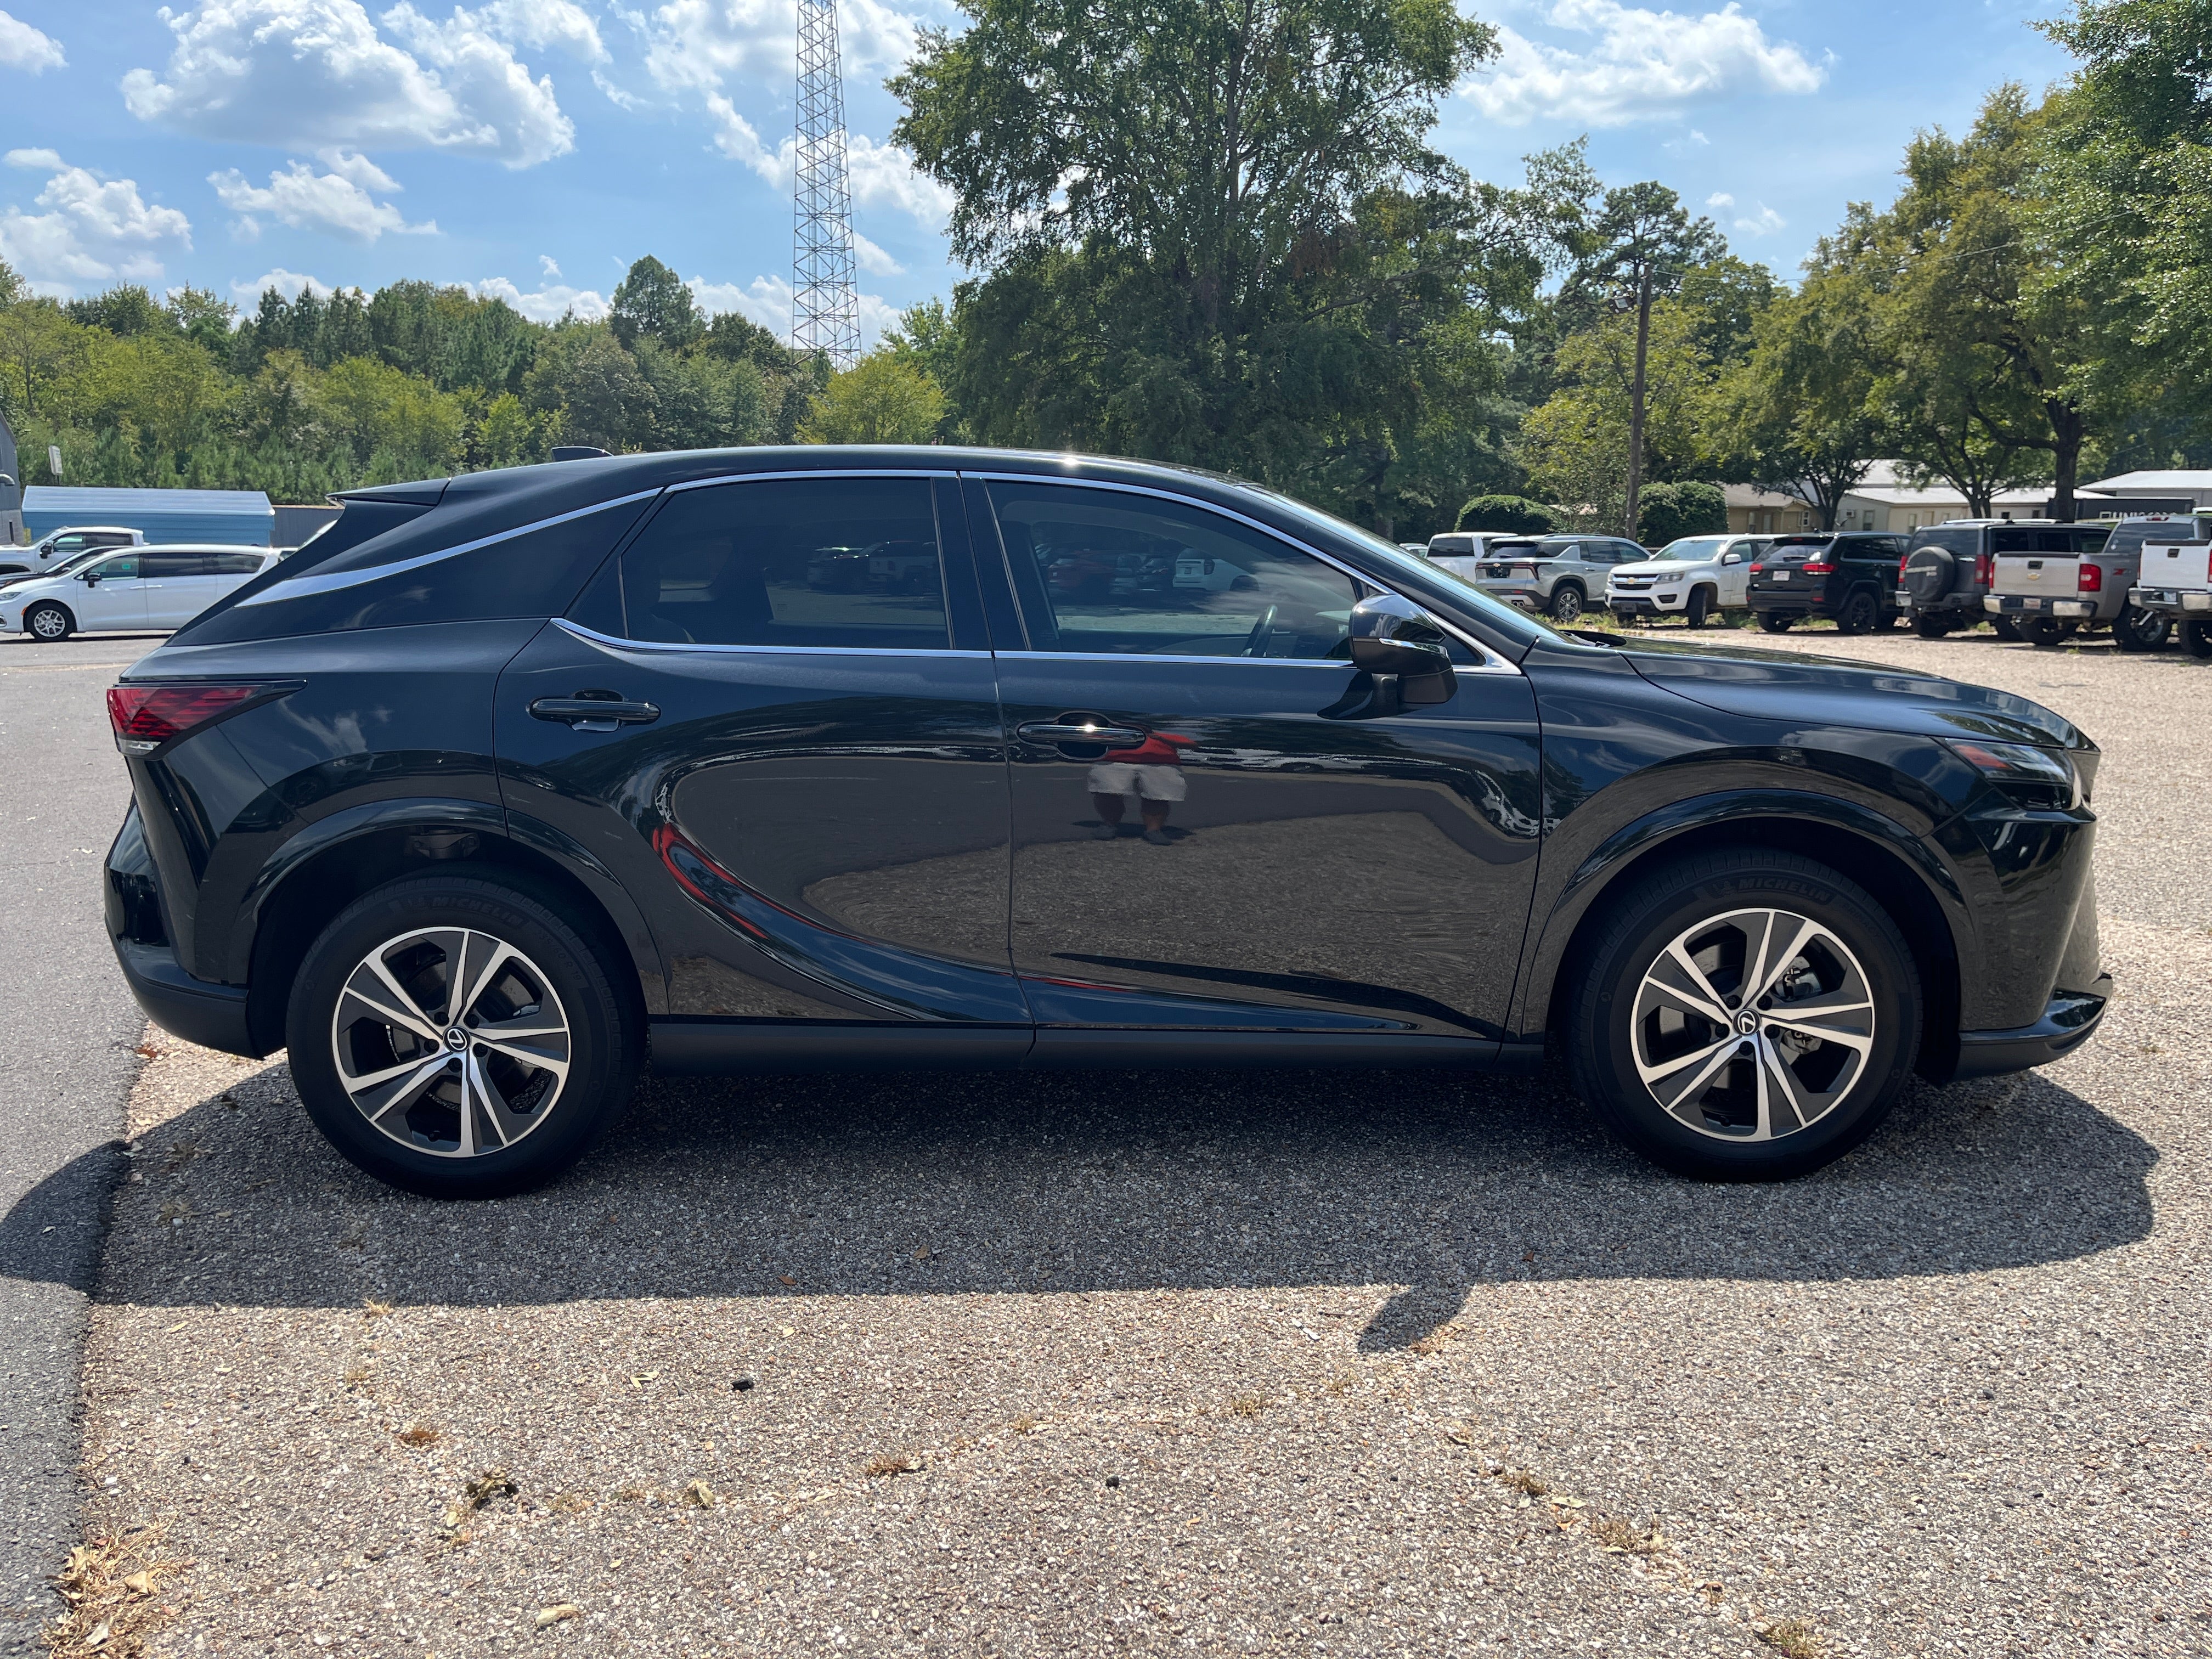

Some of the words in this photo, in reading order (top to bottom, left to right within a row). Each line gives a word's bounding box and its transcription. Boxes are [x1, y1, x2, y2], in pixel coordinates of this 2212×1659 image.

[1739, 878, 1831, 902] MICHELIN
[432, 896, 524, 926] MICHELIN
[532, 929, 567, 959] 35/60
